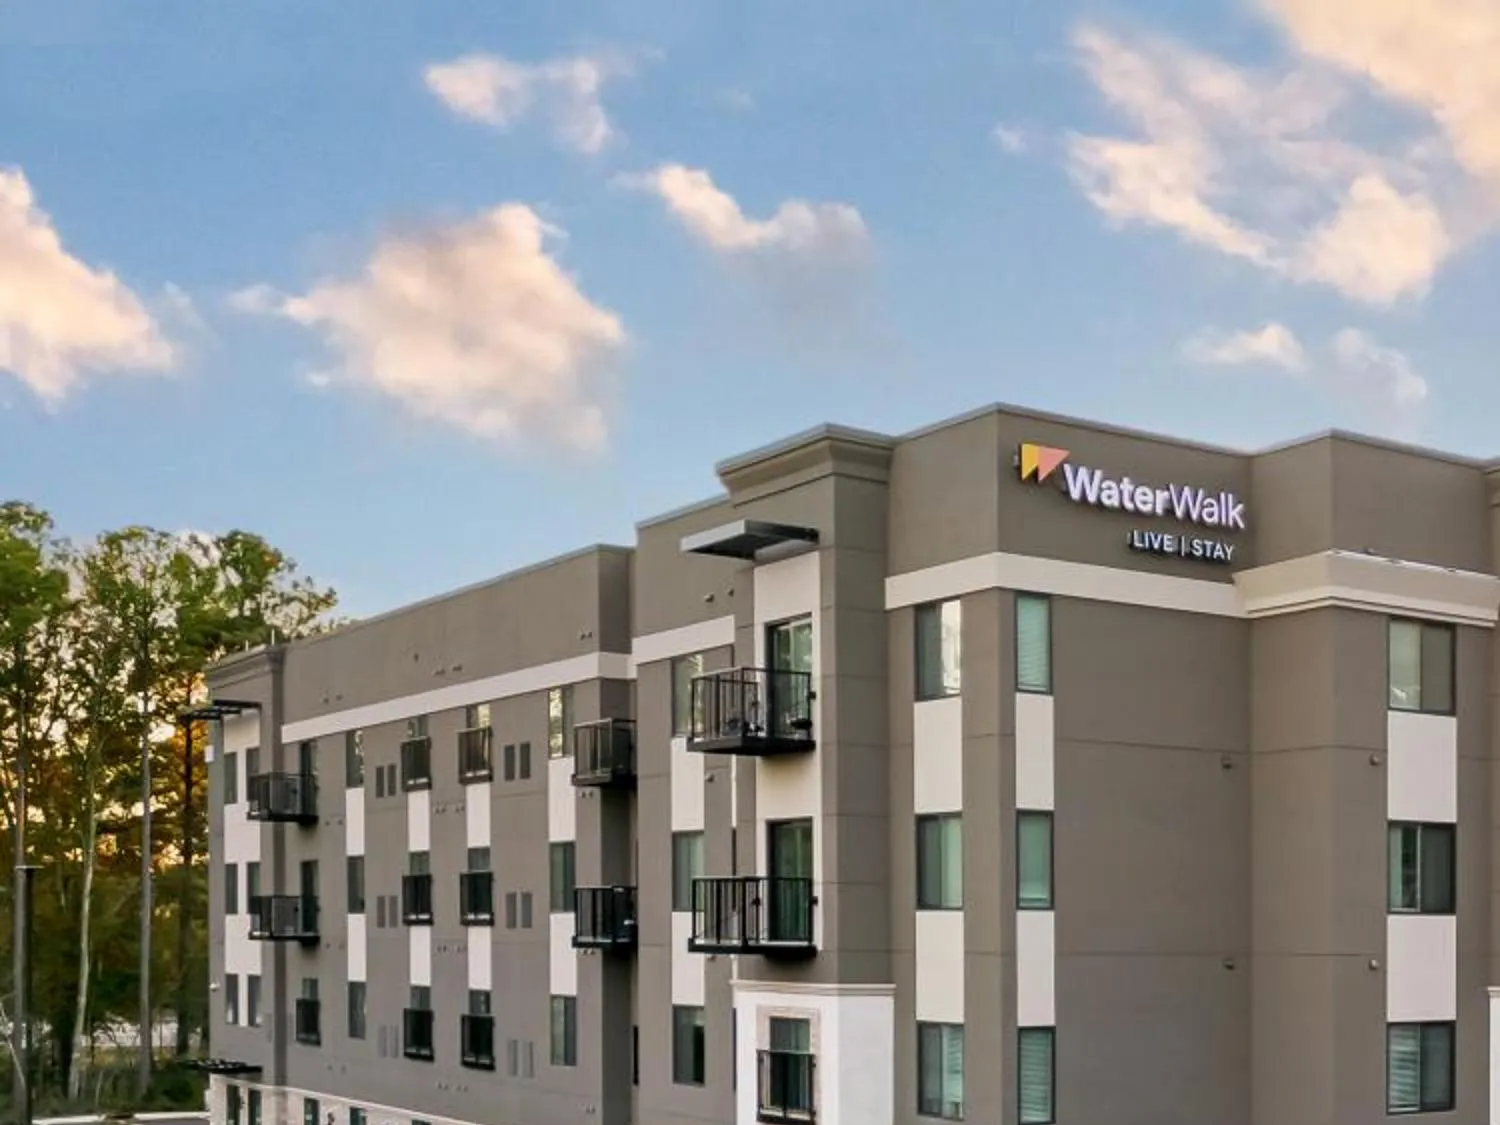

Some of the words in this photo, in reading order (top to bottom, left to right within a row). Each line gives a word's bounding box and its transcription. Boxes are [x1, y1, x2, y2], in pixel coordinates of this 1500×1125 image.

[1064, 463, 1245, 529] WaterWalk
[1133, 530, 1173, 552] LIVE
[1191, 539, 1234, 561] STAY
